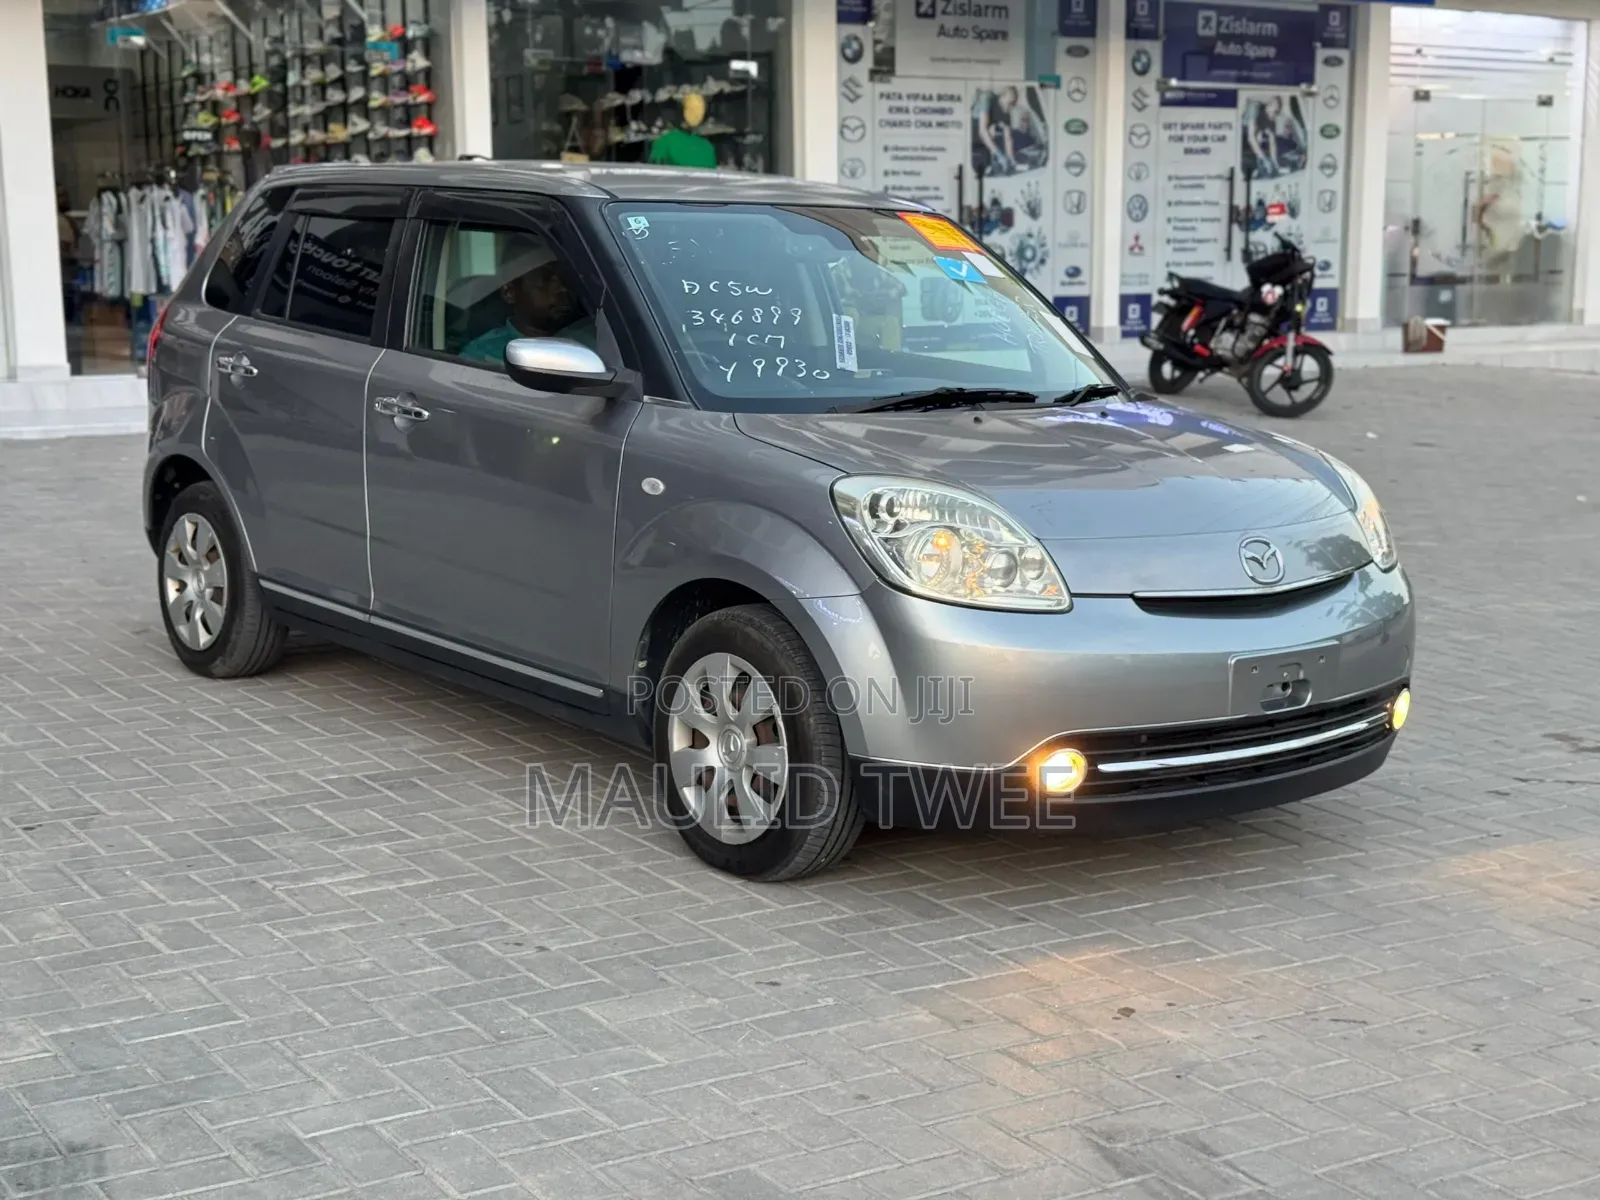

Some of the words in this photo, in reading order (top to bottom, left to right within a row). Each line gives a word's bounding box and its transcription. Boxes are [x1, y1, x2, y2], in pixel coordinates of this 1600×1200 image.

[941, 0, 1009, 19] Zislarm
[936, 23, 969, 39] Auto
[972, 24, 1009, 44] Spare
[1219, 15, 1278, 37] Zislarm
[1214, 40, 1242, 55] Auto
[1244, 41, 1277, 59] Spare
